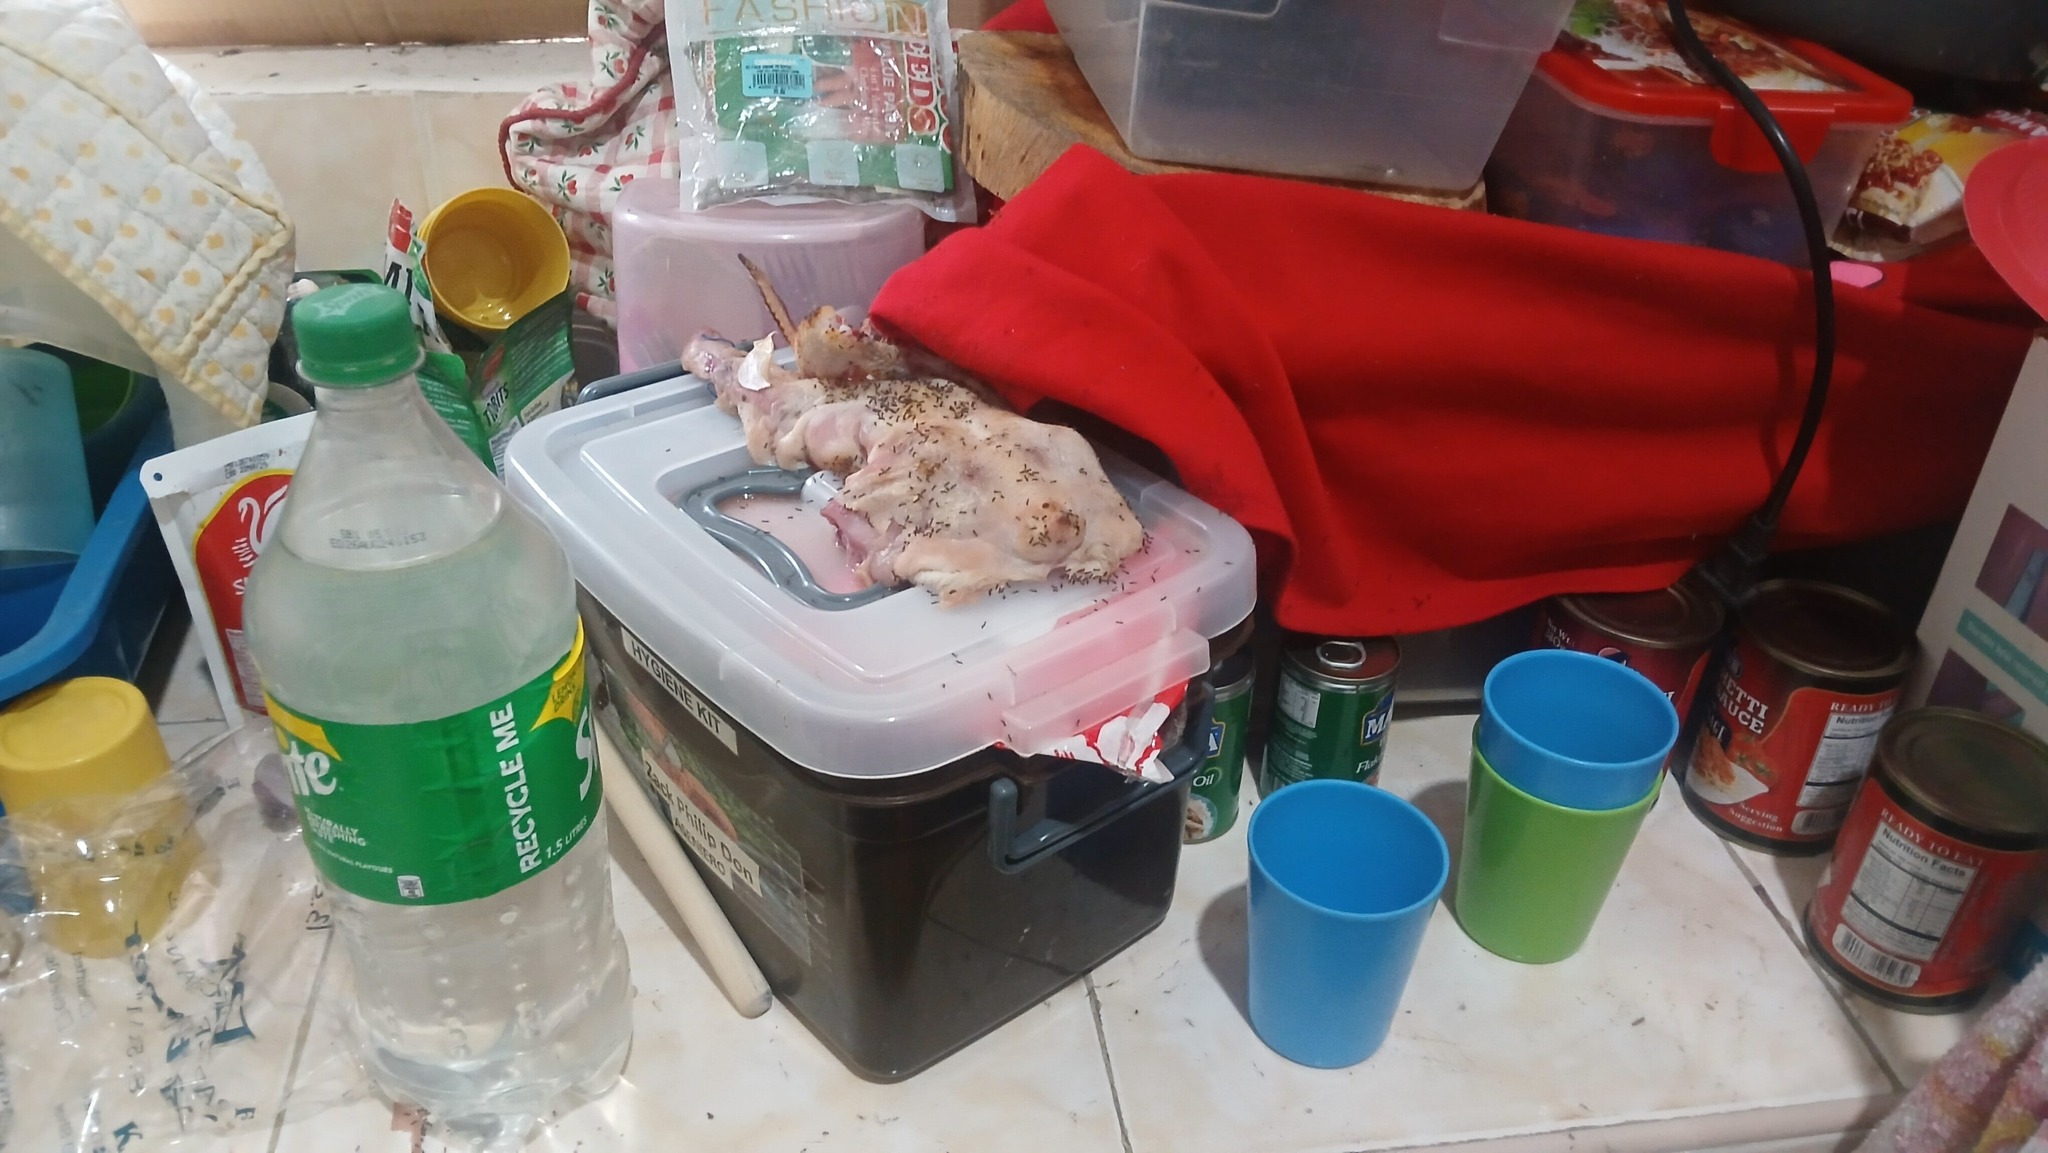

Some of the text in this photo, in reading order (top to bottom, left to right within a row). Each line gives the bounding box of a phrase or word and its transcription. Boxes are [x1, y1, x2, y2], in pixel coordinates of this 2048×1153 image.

[631, 640, 722, 735] HYGIENE KIT
[489, 701, 543, 874] RECYCLE ME
[1192, 773, 1215, 787] Oil
[545, 815, 588, 859] 1.5 LITRES
[645, 760, 754, 885] Zack Philip Don
[1881, 808, 1926, 844] READY
[1930, 840, 1950, 857] TO
[1881, 827, 1967, 878] Nutrition Facts
